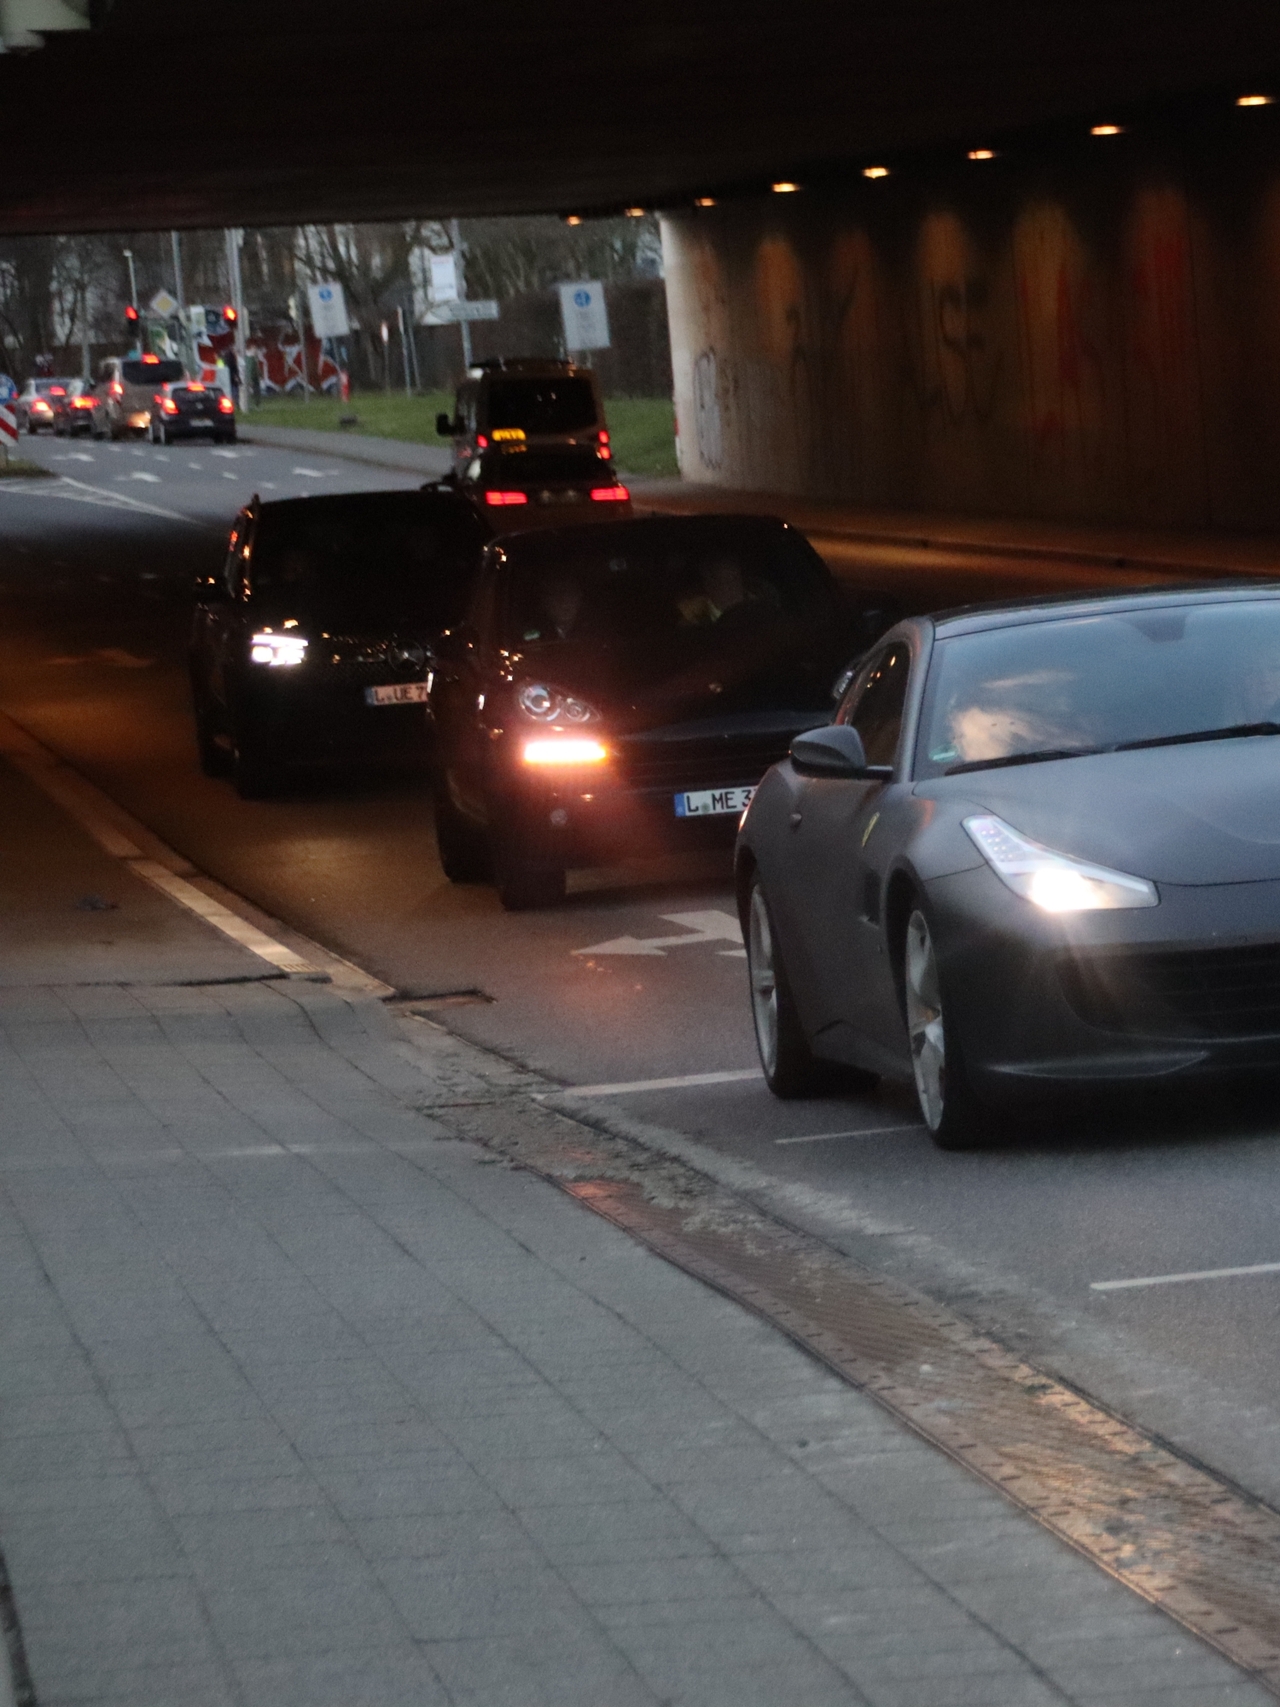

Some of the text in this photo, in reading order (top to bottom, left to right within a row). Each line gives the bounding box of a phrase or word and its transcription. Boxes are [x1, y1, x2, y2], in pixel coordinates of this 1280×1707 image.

[686, 789, 757, 813] L ME 3
